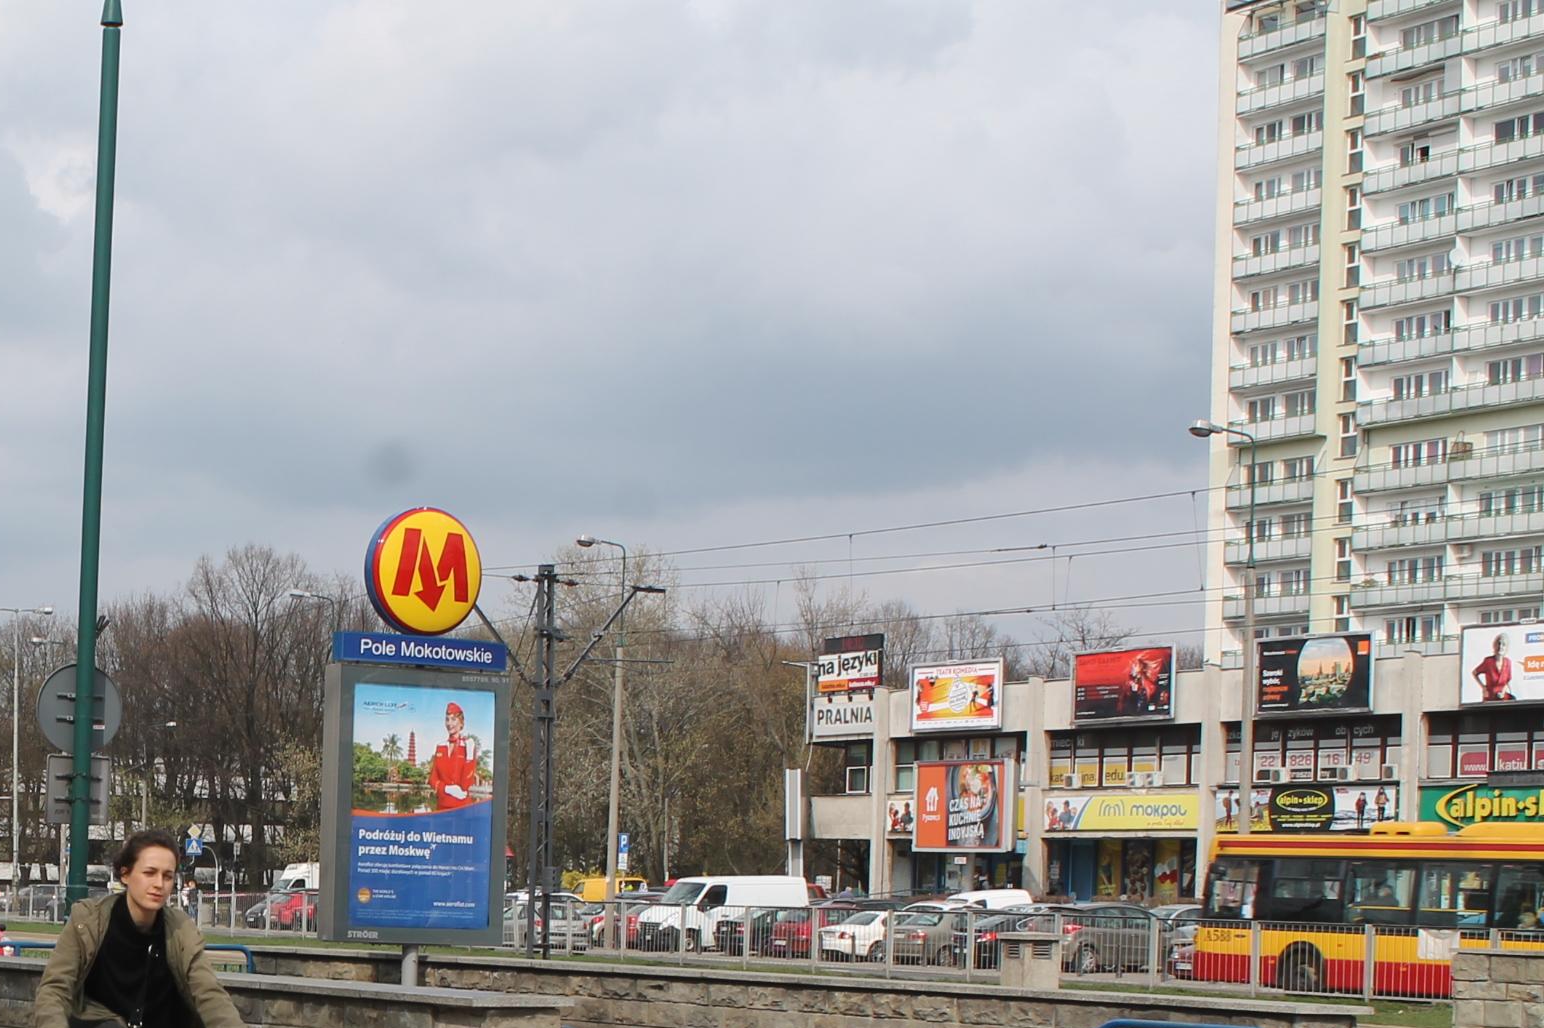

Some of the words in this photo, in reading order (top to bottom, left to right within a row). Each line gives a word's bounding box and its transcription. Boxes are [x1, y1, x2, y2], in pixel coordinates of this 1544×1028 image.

[360, 638, 396, 656] Pole
[400, 640, 493, 664] Mokotowskie
[817, 661, 834, 676] na
[837, 650, 877, 677] języki
[936, 667, 952, 675] TEATR
[953, 666, 978, 674] KOMEDIA
[817, 706, 873, 725] PRALNIA
[1260, 755, 1275, 768] 22
[1289, 754, 1312, 766] 826
[949, 797, 968, 812] CZAS
[970, 795, 981, 810] NA
[359, 829, 405, 843] Podróżuj
[407, 832, 420, 842] do
[422, 832, 473, 844] Wietnamu
[948, 821, 985, 840] INDYJSKĄ
[621, 834, 627, 848] P
[358, 846, 387, 856] przez
[389, 845, 431, 859] Moskwę
[347, 930, 378, 939] STRÖER
